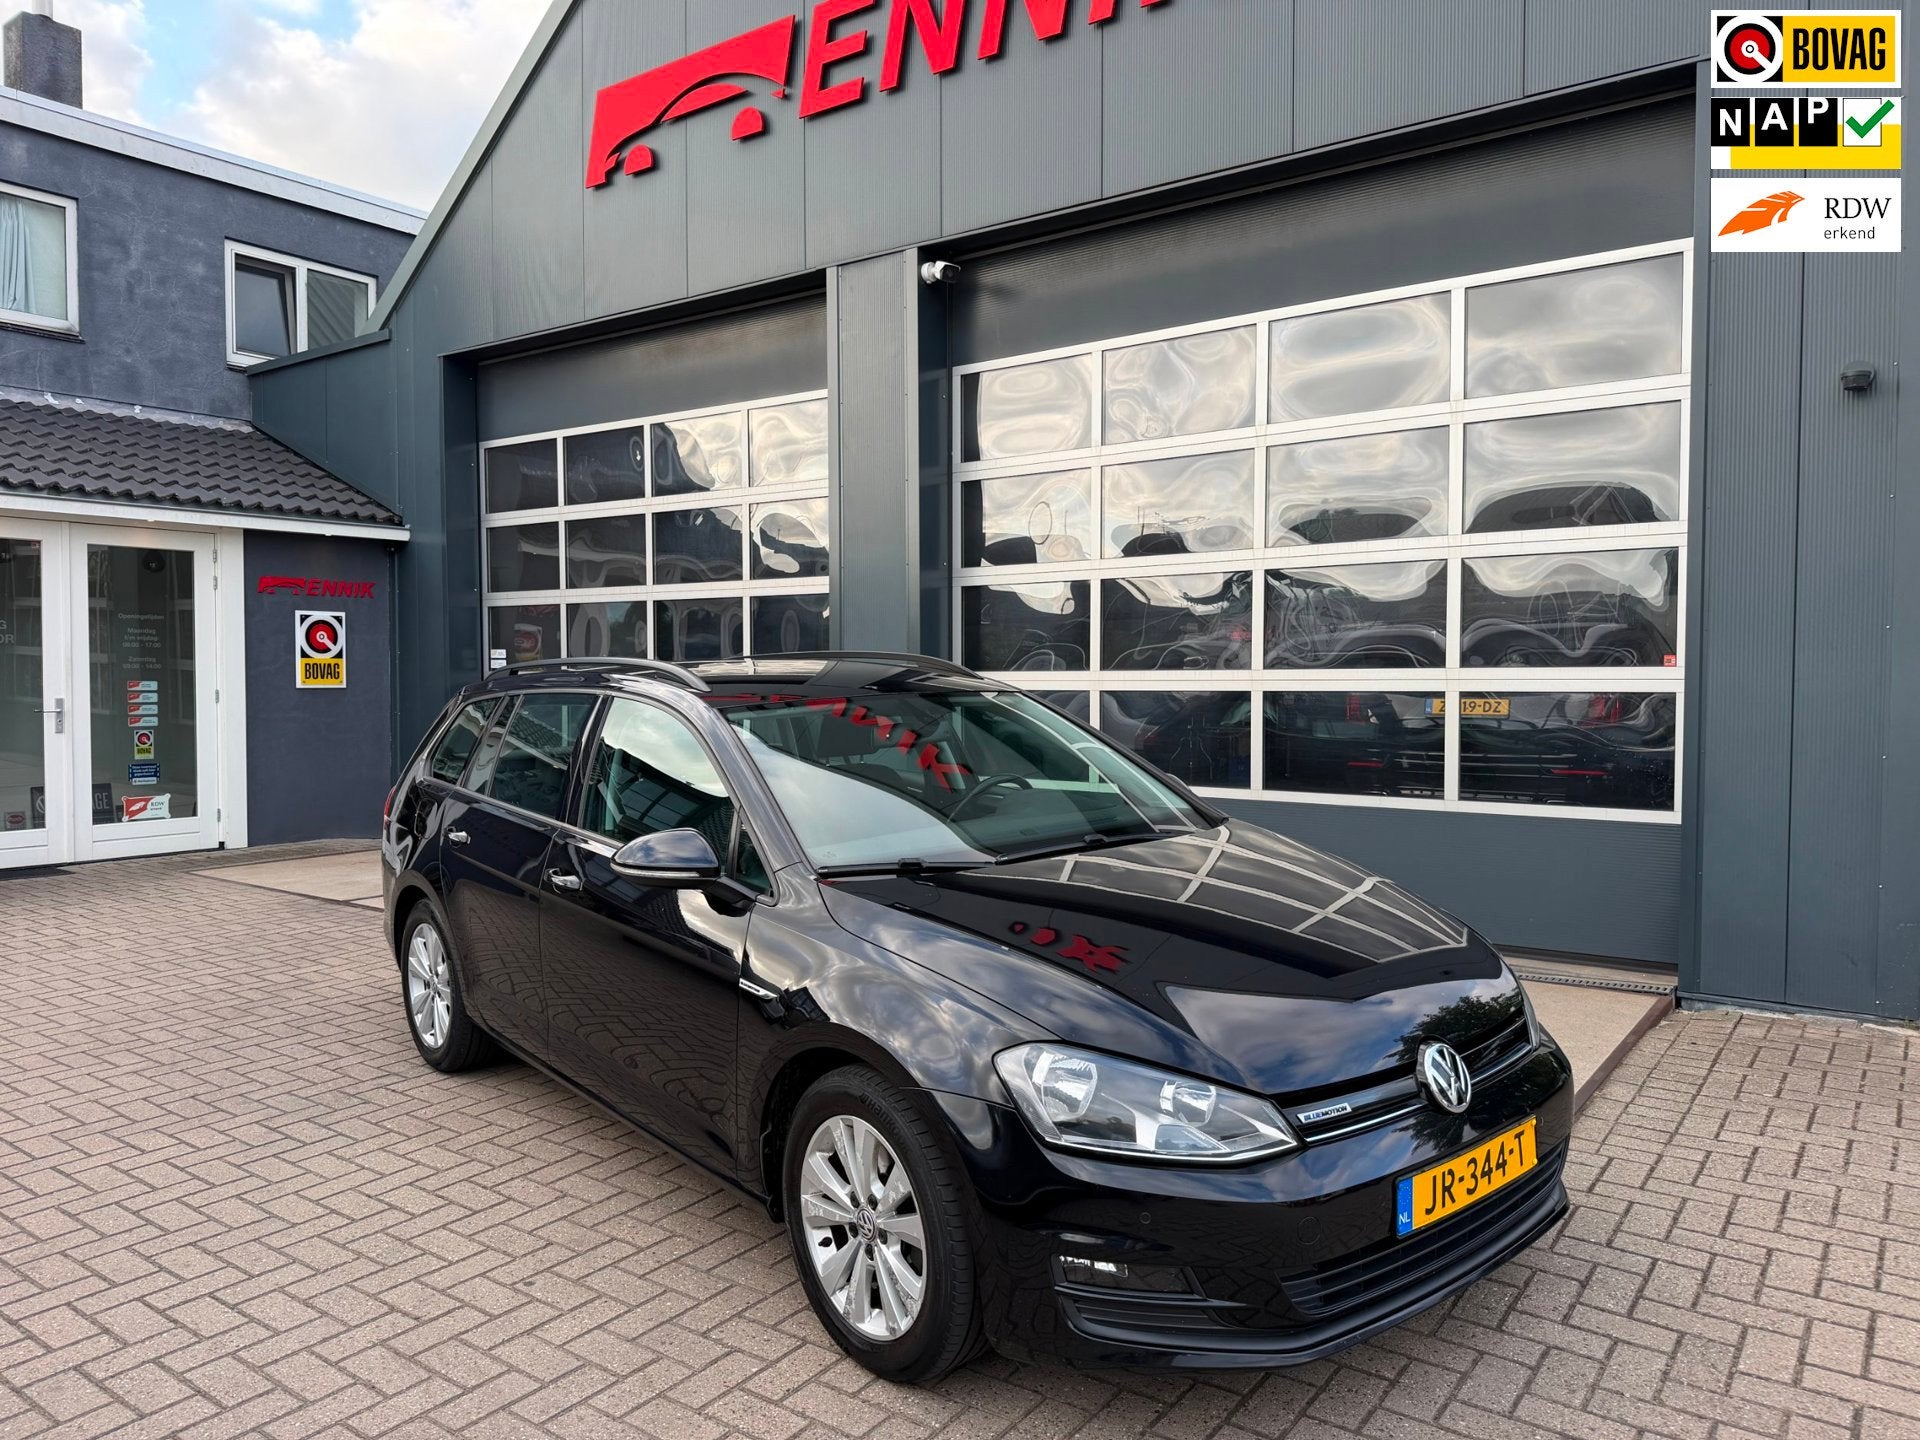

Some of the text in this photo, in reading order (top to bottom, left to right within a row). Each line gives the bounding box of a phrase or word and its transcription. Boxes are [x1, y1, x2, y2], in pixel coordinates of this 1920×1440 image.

[305, 662, 340, 680] BOVAG
[1424, 1129, 1525, 1216] JR-344-T
[1398, 1211, 1411, 1226] NL
